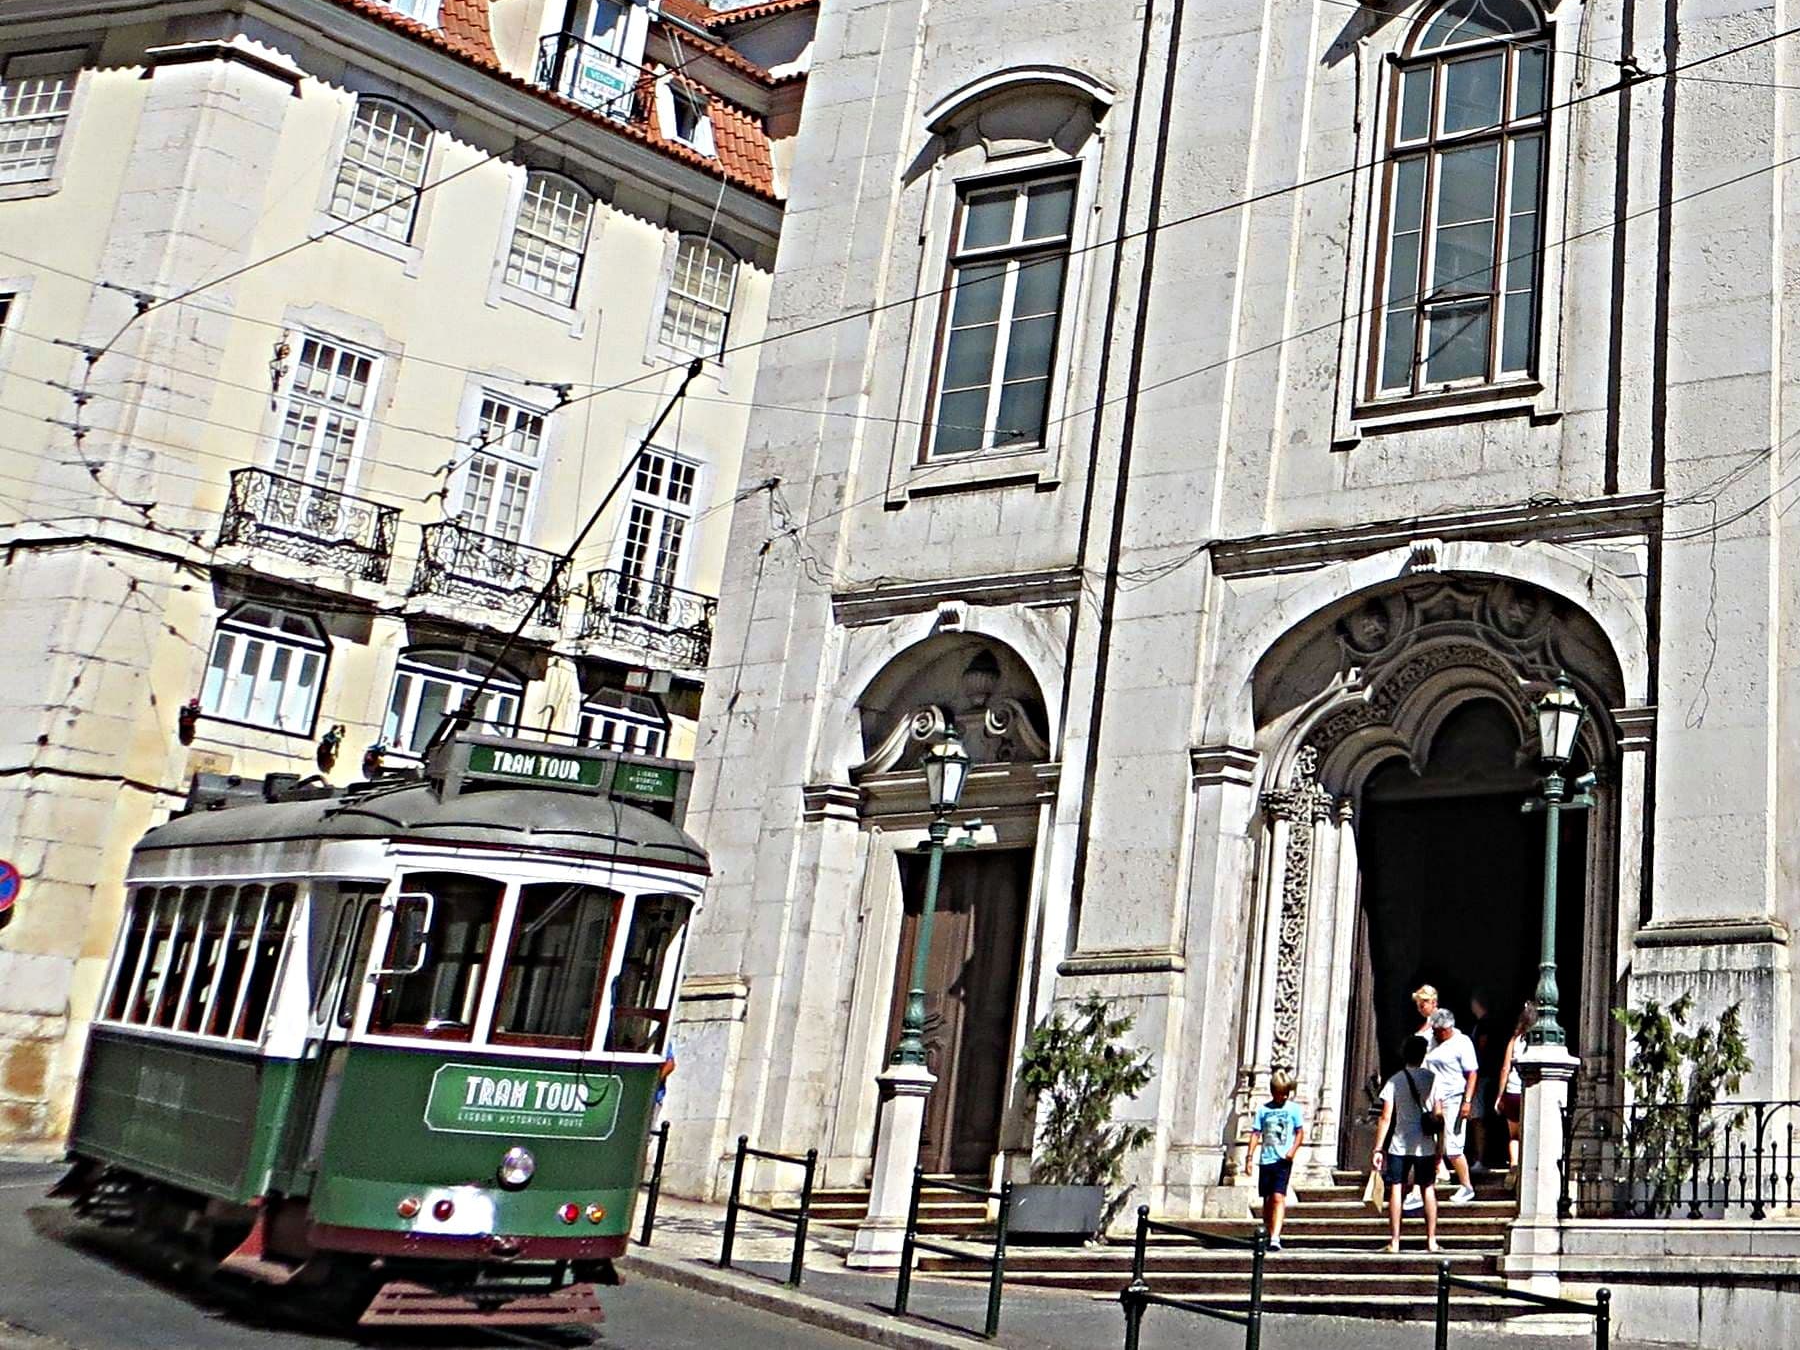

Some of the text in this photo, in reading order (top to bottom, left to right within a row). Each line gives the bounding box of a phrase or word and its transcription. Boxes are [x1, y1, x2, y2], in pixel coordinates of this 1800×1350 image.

[492, 751, 581, 781] TRAM TOUR
[465, 1076, 589, 1112] TRAM TOUR
[457, 1112, 494, 1123] LISBON
[499, 1114, 553, 1126] HISTORICAL
